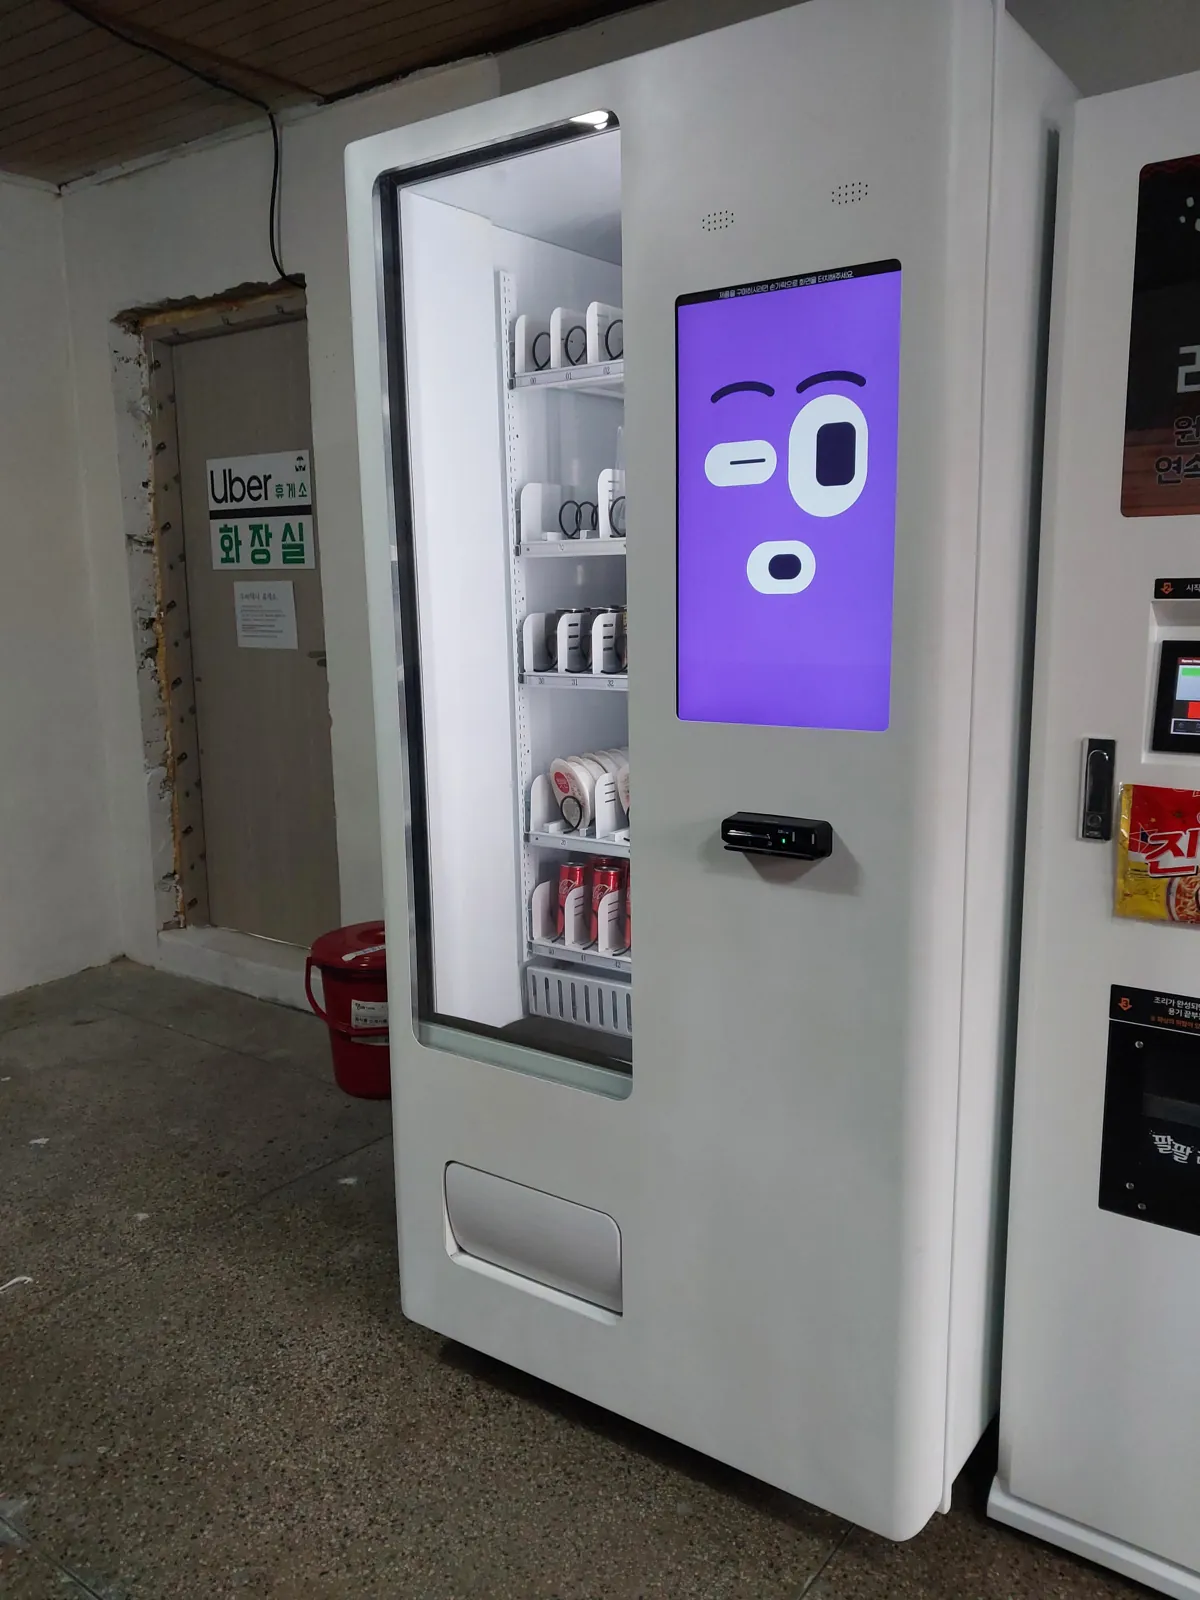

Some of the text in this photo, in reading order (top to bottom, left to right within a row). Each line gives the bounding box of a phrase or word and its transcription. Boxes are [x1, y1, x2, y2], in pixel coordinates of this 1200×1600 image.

[209, 467, 308, 504] Uber 휴게소
[218, 522, 306, 565] 화장실
[1146, 829, 1200, 877] 진
[1153, 996, 1175, 1007] 조리가
[1151, 1133, 1193, 1164] 팔팔
